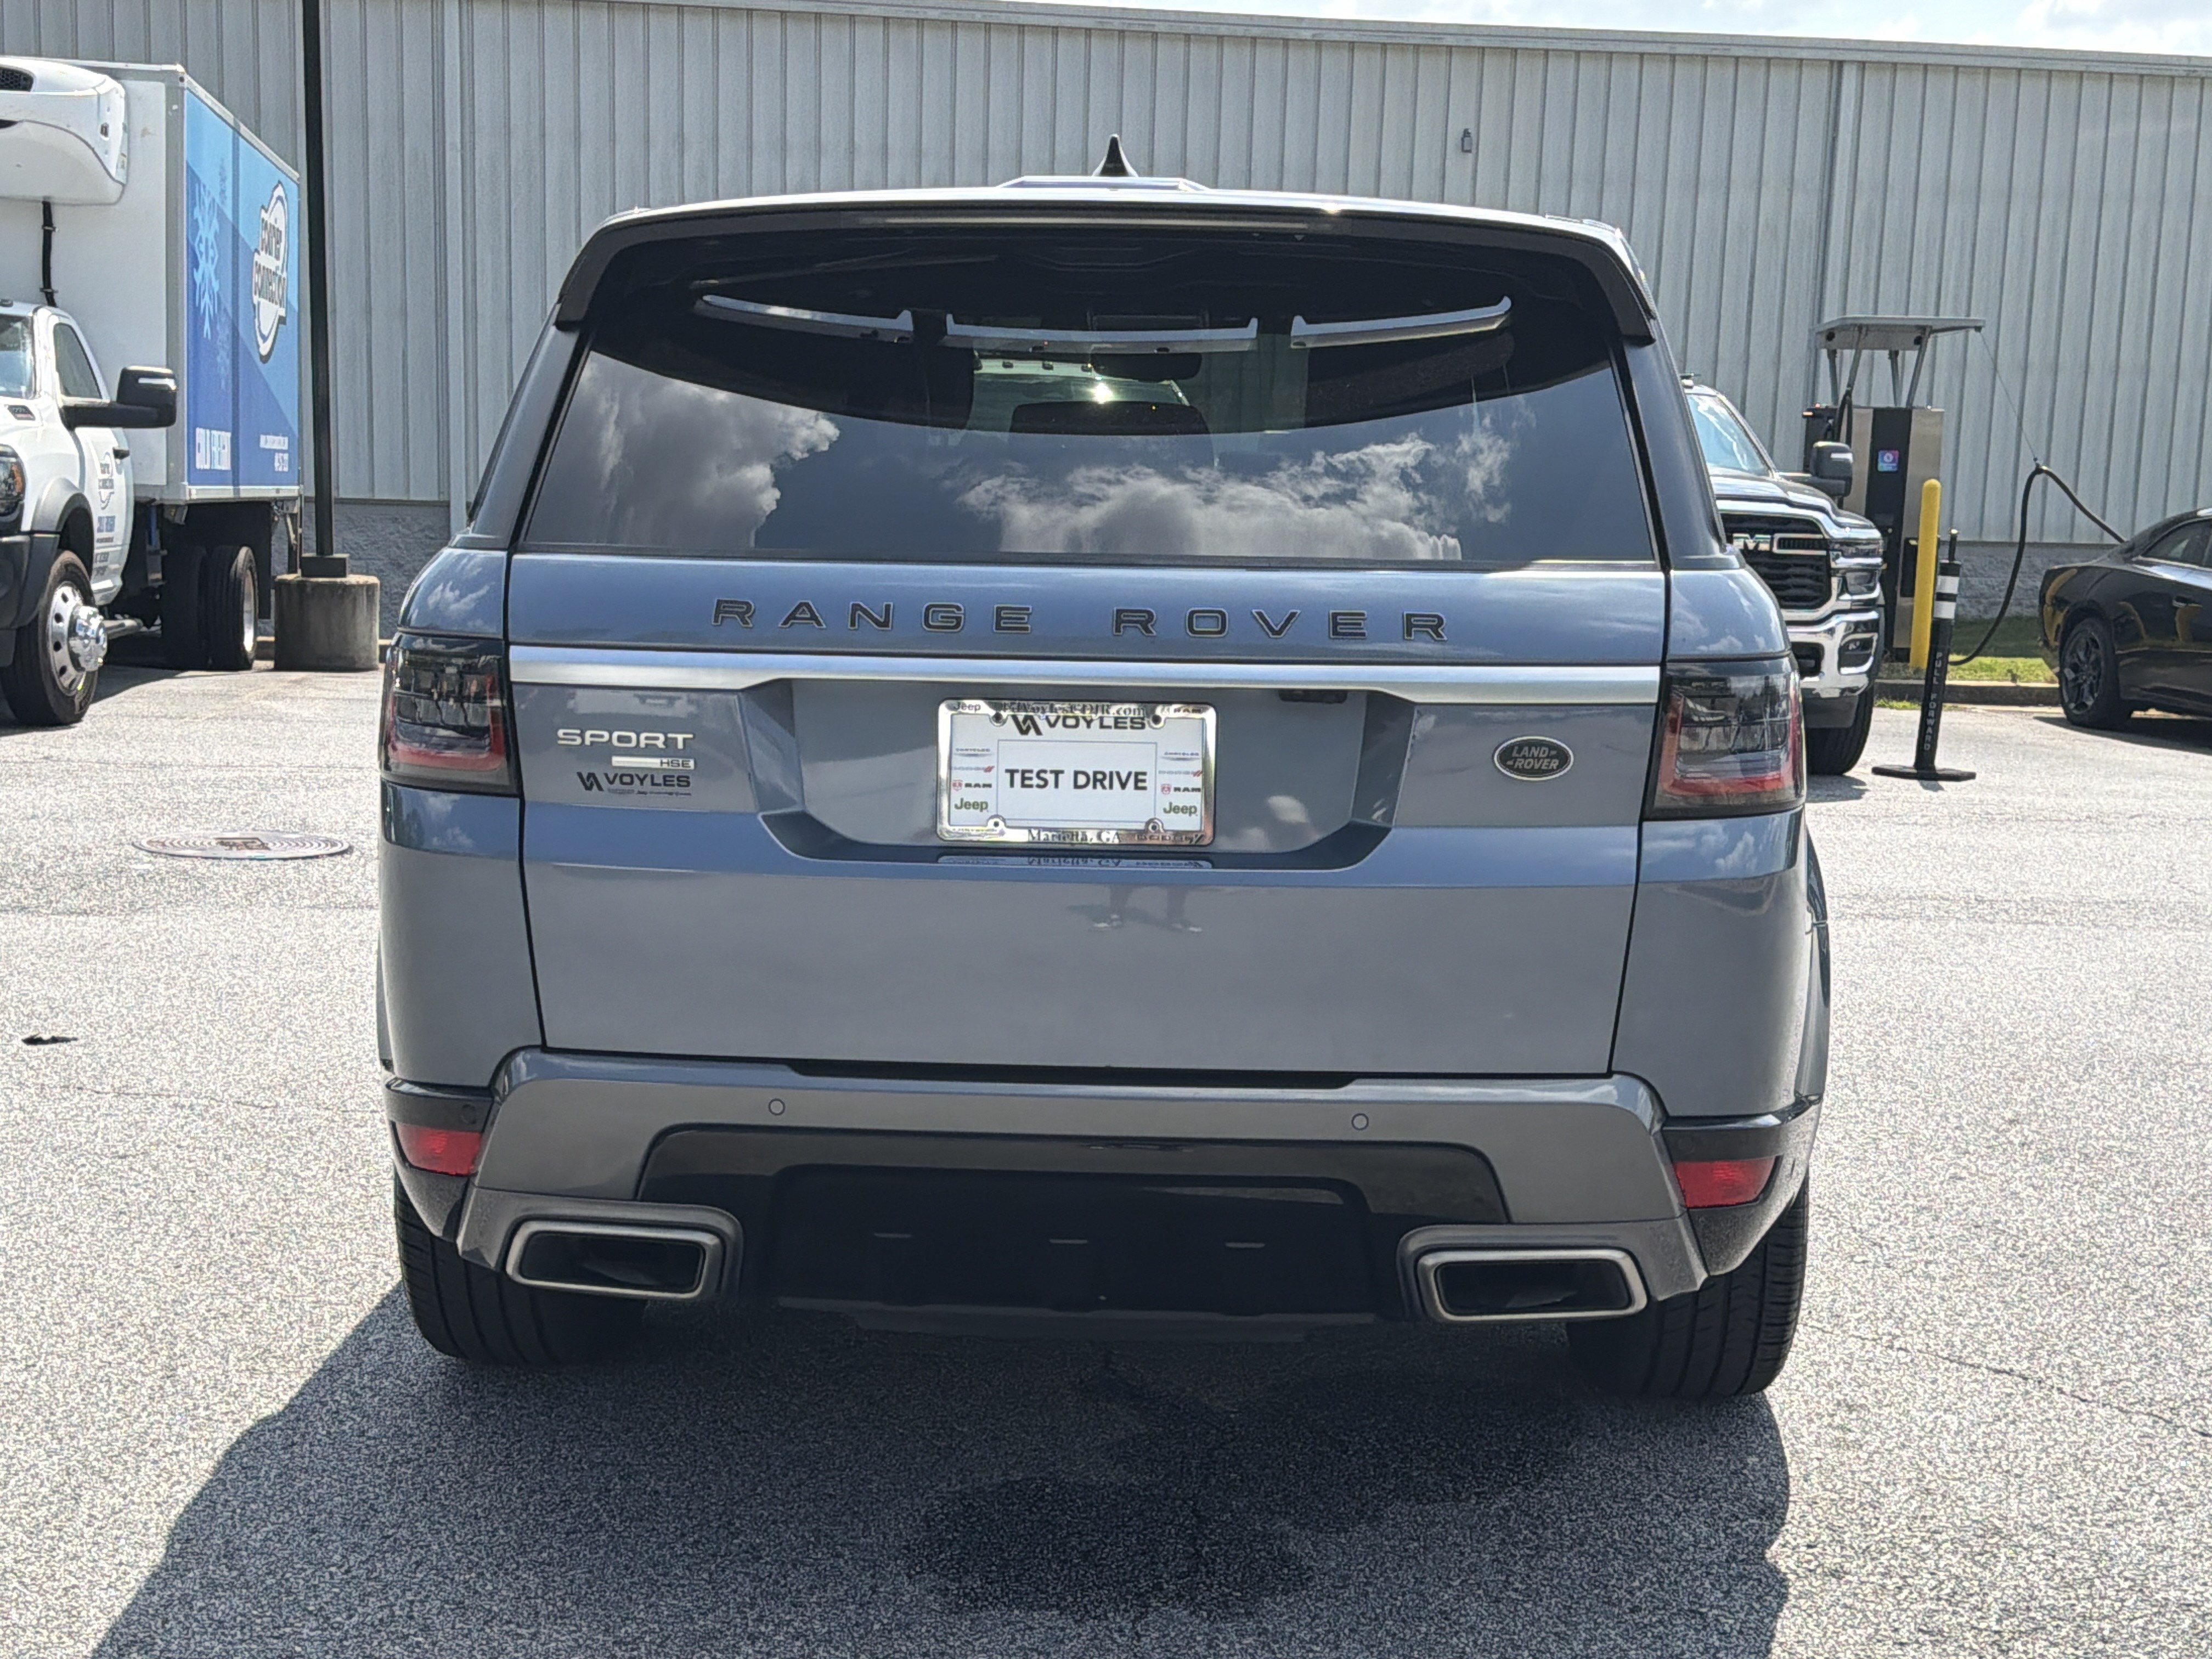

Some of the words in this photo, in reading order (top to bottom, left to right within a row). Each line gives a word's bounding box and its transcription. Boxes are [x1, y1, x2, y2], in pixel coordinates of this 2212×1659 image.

[713, 598, 1032, 633] RANGE
[1113, 607, 1448, 641] ROVER
[1932, 651, 1943, 685] PULL
[953, 702, 981, 713] Jeep
[1046, 715, 1146, 730] VOYLES
[1923, 692, 1938, 751] FORWARD
[557, 729, 694, 749] SPORT
[1512, 746, 1549, 758] LAND
[660, 759, 691, 768] HSE
[1514, 758, 1560, 770] ROVER
[604, 772, 691, 787] VOYLES
[1005, 768, 1065, 789] TEST
[1073, 770, 1148, 791] DRIVE
[954, 797, 989, 812] Jeep
[1163, 801, 1198, 817] Jeep
[1097, 830, 1121, 843] GA
